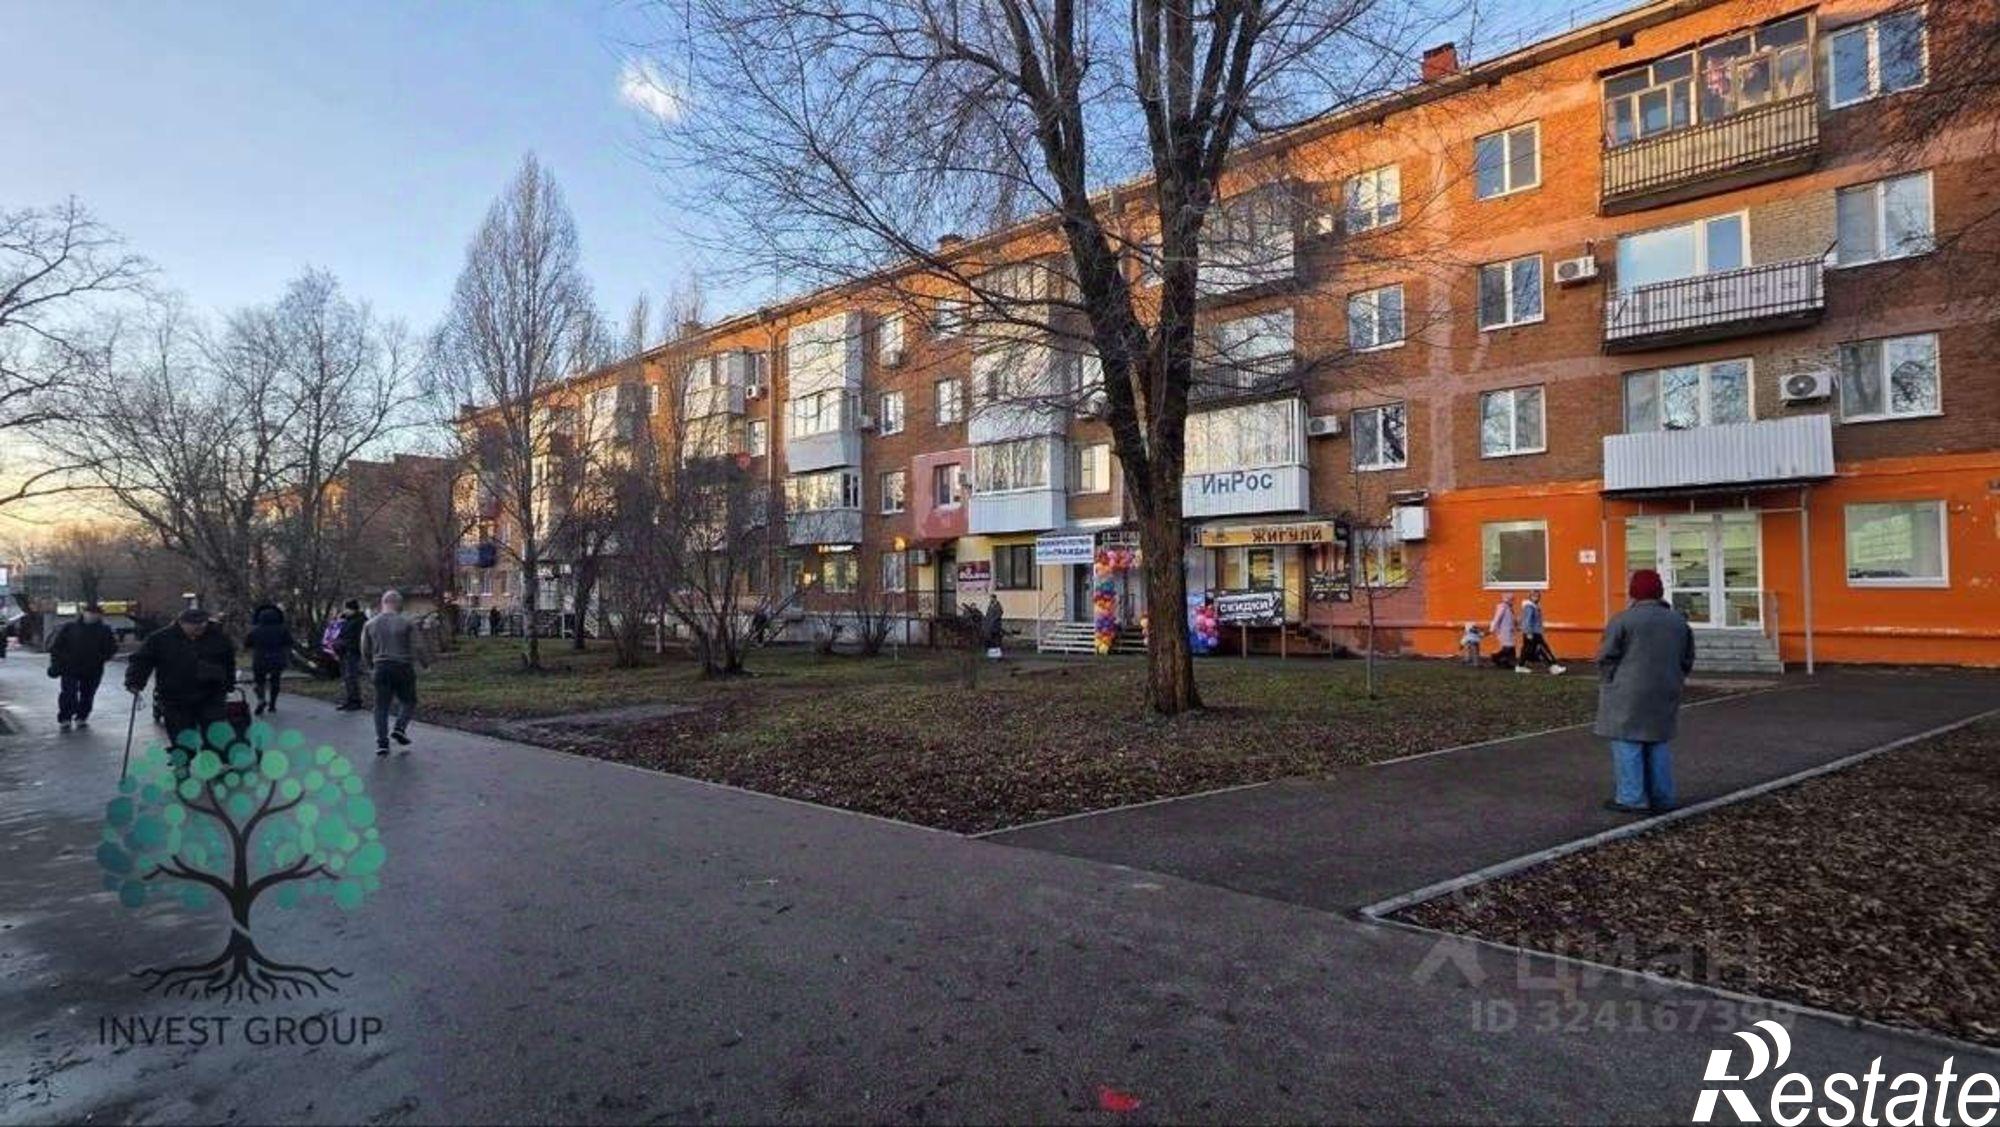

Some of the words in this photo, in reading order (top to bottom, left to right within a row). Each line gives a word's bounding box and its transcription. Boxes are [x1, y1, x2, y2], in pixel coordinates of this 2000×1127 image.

[1202, 471, 1273, 494] ИнРос
[1252, 525, 1322, 543] ЖИГУЛИ
[1220, 600, 1270, 614] СКИДКИ
